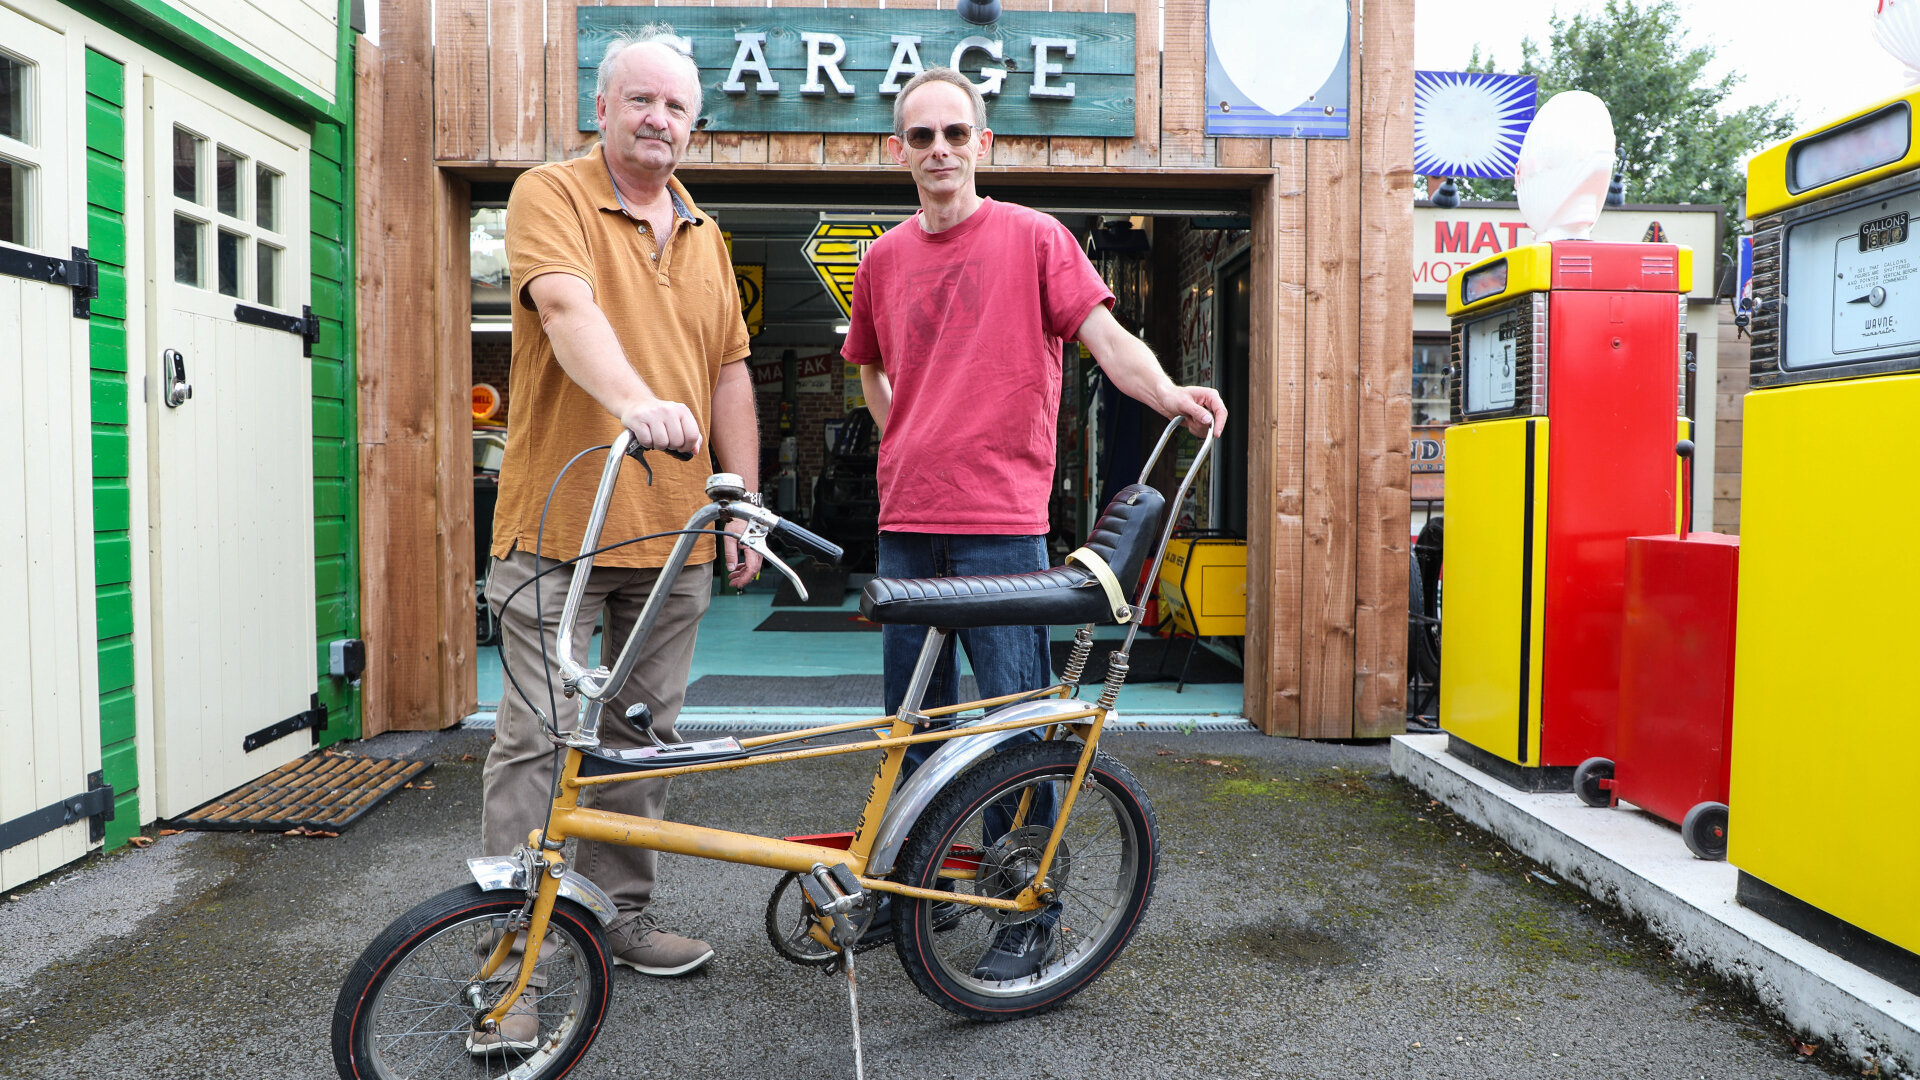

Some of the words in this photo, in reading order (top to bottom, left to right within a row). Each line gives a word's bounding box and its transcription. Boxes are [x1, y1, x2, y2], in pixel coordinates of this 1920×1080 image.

[657, 32, 1077, 97] ARAGE
[1862, 214, 1906, 234] GALLONS
[1434, 220, 1530, 253] MAT
[1883, 259, 1907, 268] GALLONS
[1864, 315, 1894, 330] WAYNE
[756, 356, 827, 383] MAFAK
